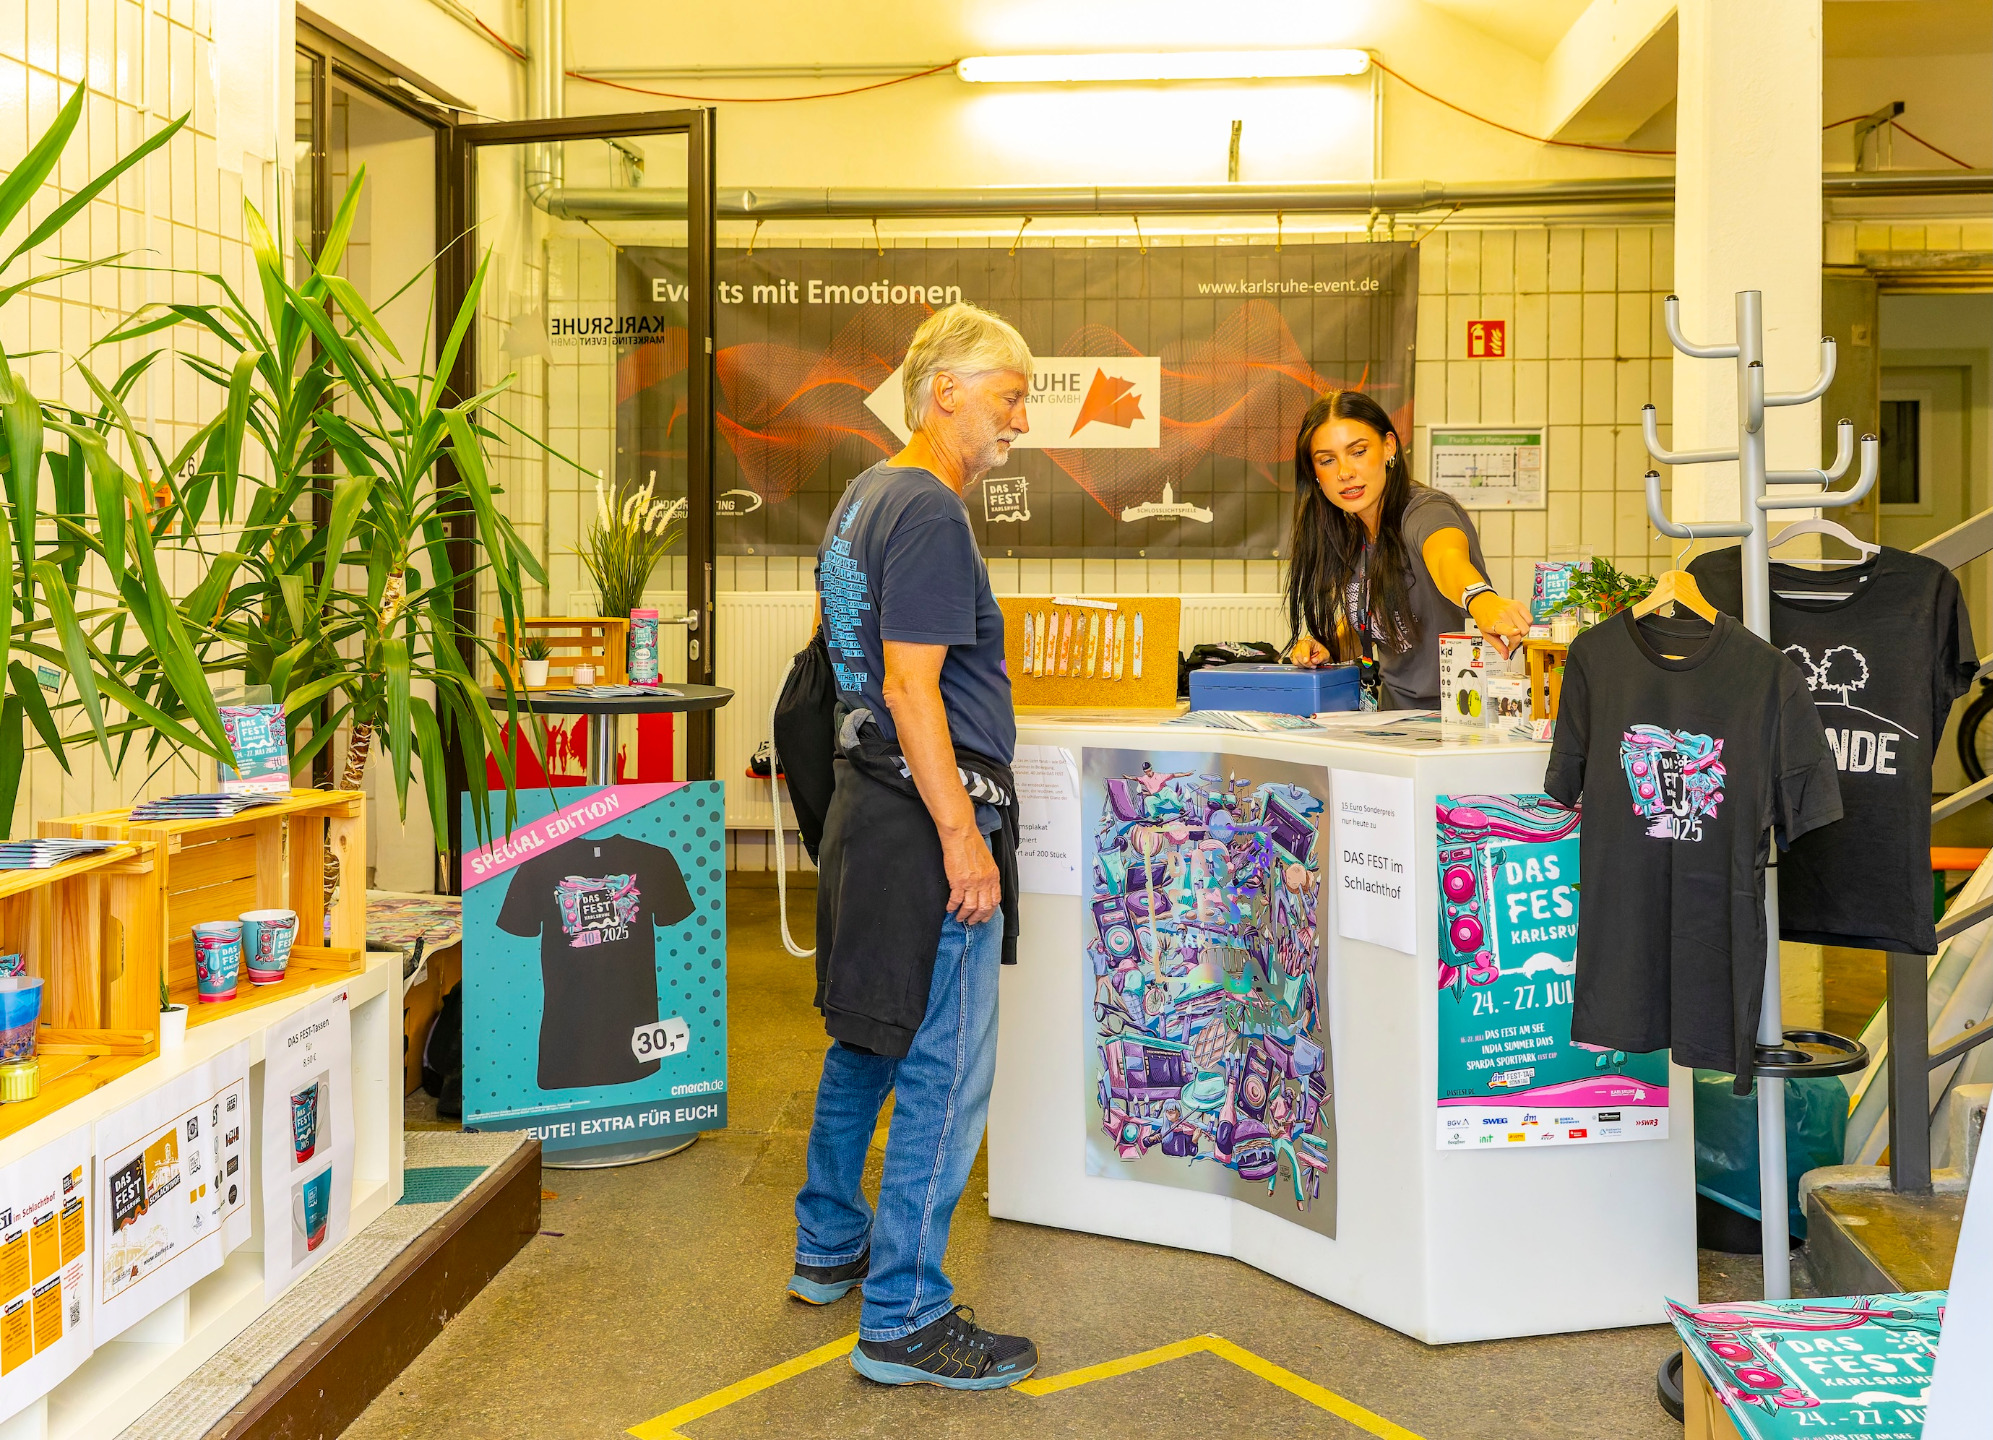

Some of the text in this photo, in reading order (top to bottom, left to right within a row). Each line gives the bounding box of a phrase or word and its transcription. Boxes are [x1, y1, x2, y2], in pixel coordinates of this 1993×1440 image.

[652, 278, 962, 304] Evts mit Emotionen
[1198, 277, 1380, 295] www.karlsruhe-event.de
[1047, 394, 1081, 404] GMBH
[990, 484, 1009, 494] DAS
[991, 493, 1021, 505] FEST
[1547, 580, 1566, 588] FEST
[242, 725, 266, 737] FEST
[1825, 727, 1900, 775] NDE
[1341, 802, 1395, 817] 15 Euro Sonderpreis
[1352, 818, 1369, 828] heute
[1672, 817, 1703, 842] 025
[470, 793, 620, 875] SPECIAL EDITION
[1024, 849, 1036, 857] auf
[1037, 850, 1049, 858] 200
[1343, 850, 1403, 874] DAS FEST im
[1505, 855, 1560, 886] DAS
[1344, 875, 1401, 900] Schlachthof
[582, 894, 600, 904] DAS
[582, 901, 611, 915] FEST
[1506, 885, 1576, 924] FES
[602, 924, 629, 943] 2025
[1511, 923, 1578, 945] KARLSRU
[222, 945, 237, 956] DAS
[278, 939, 292, 949] FES
[1471, 990, 1500, 1016] 24.
[1514, 984, 1540, 1011] 27.
[1544, 979, 1575, 1008] JUL
[287, 1018, 330, 1048] DAS FEST-Tassen
[1485, 1029, 1500, 1040] DAS
[1500, 1026, 1518, 1038] FEST
[1519, 1025, 1531, 1035] AM
[1532, 1022, 1546, 1033] SEE
[636, 1029, 685, 1054] 30,-
[1481, 1036, 1554, 1055] INDIA SUMMER DAYS
[1466, 1058, 1496, 1071] SPARDA
[1496, 1052, 1537, 1068] SPORTPARK
[1492, 1069, 1534, 1082] dm FEST-TAG
[671, 1080, 724, 1096] cmerch.de
[296, 1113, 311, 1128] FEST
[527, 1103, 719, 1141] EUTE! EXTRA FÜR EUCH
[1482, 1117, 1508, 1125] SWEG
[1523, 1113, 1537, 1122] dm
[114, 1170, 132, 1193] DAS
[148, 1173, 181, 1207] SCHLACHTHOF
[115, 1177, 142, 1210] FEST
[13, 1213, 21, 1223] im
[22, 1190, 56, 1218] Schlachthof
[1784, 1336, 1864, 1354] DAS
[1799, 1351, 1928, 1374] FEST
[1791, 1410, 1836, 1426] 24.
[1849, 1409, 1894, 1425] 27.
